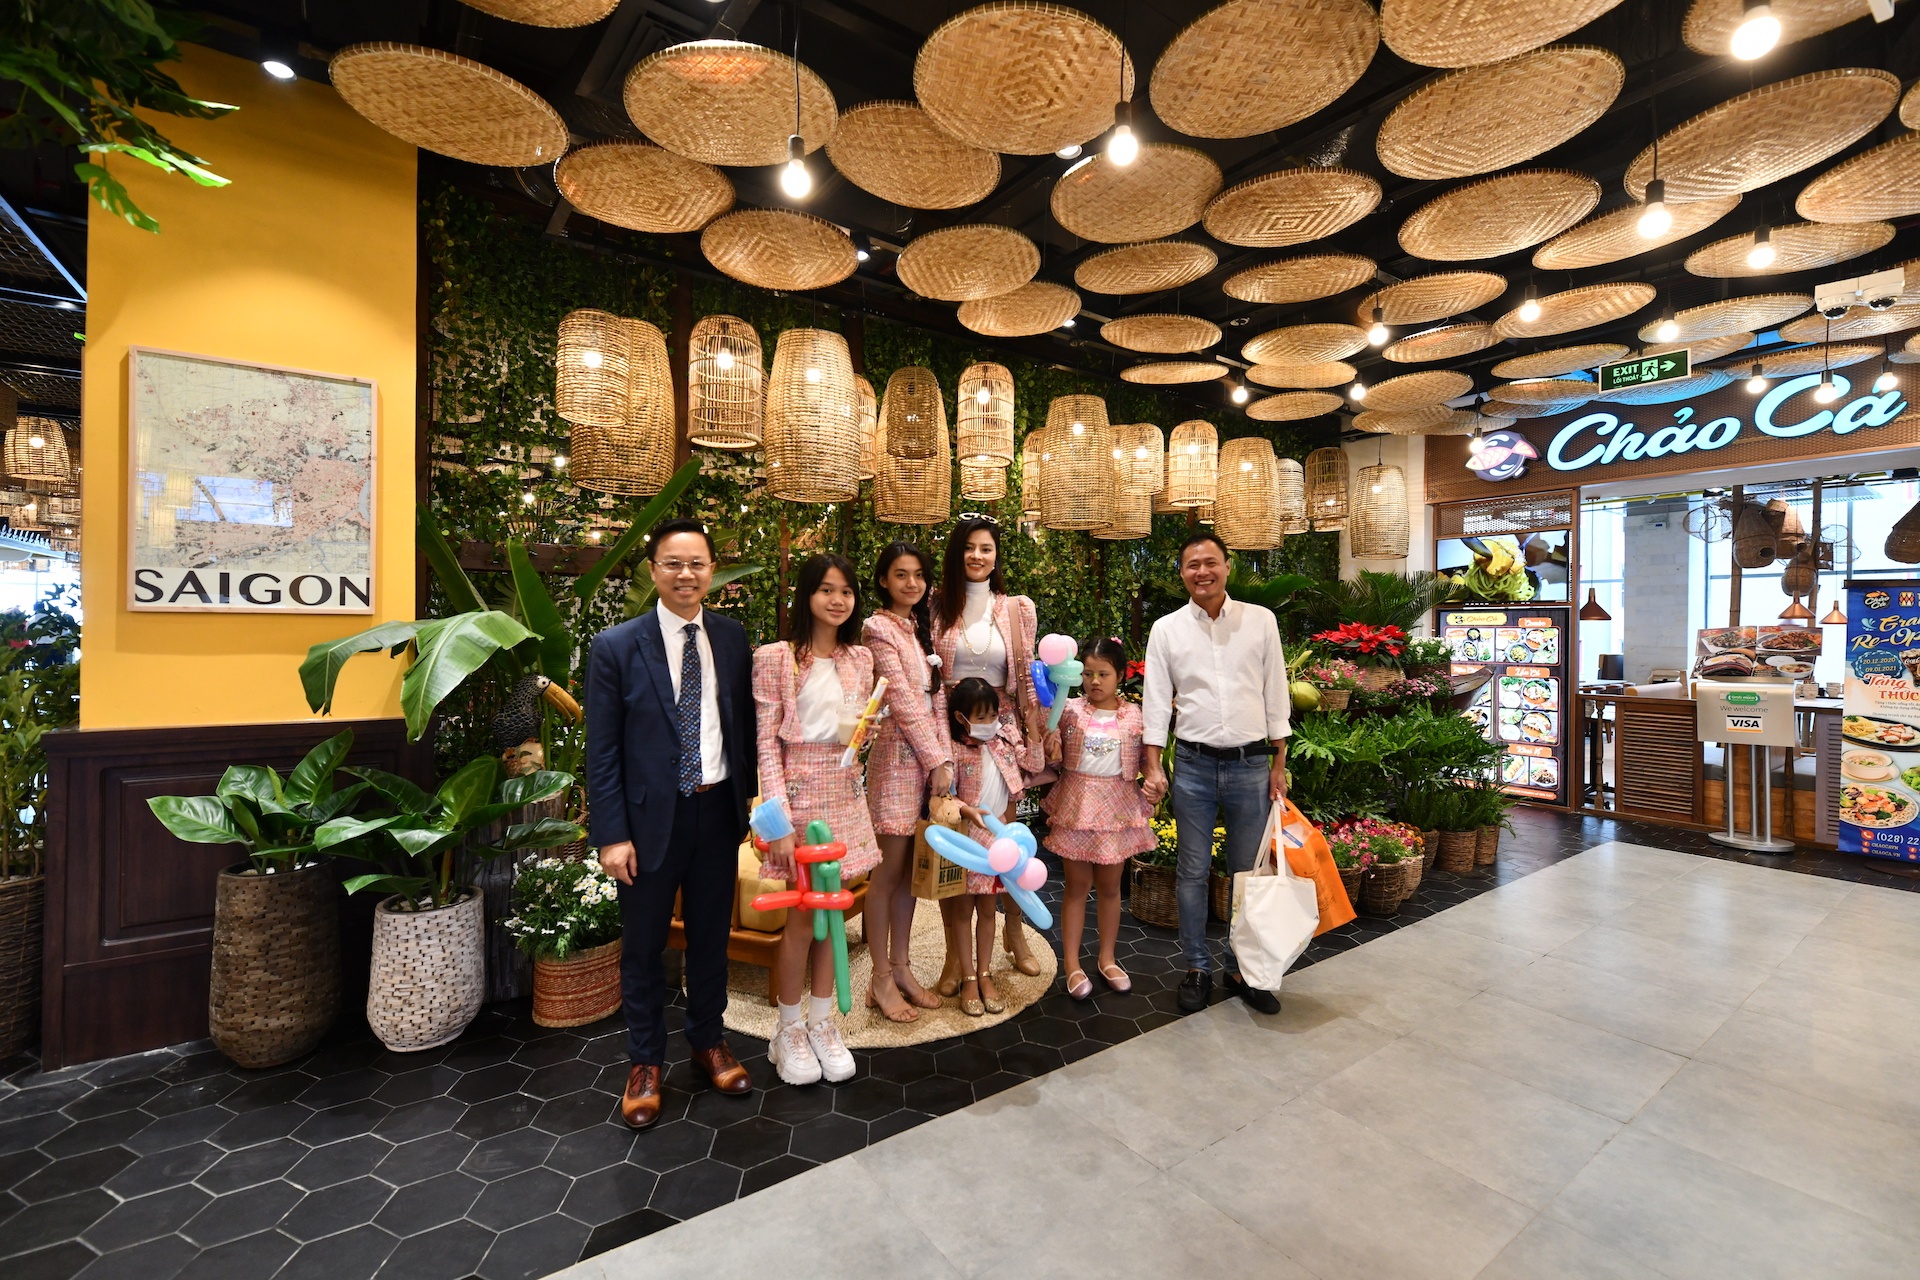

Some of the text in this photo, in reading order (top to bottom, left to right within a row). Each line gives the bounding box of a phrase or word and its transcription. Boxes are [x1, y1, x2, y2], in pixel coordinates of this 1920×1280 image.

[1613, 364, 1639, 377] EXIT
[1547, 373, 1907, 471] Chảo Cá
[134, 568, 370, 608] SAIGON
[1879, 615, 1920, 632] Gra
[1862, 657, 1896, 665] 20.12.2020
[1863, 673, 1911, 690] Tặng
[1729, 719, 1759, 728] VISA
[1877, 832, 1904, 844] (028)
[938, 866, 963, 884] BE BRAVE
